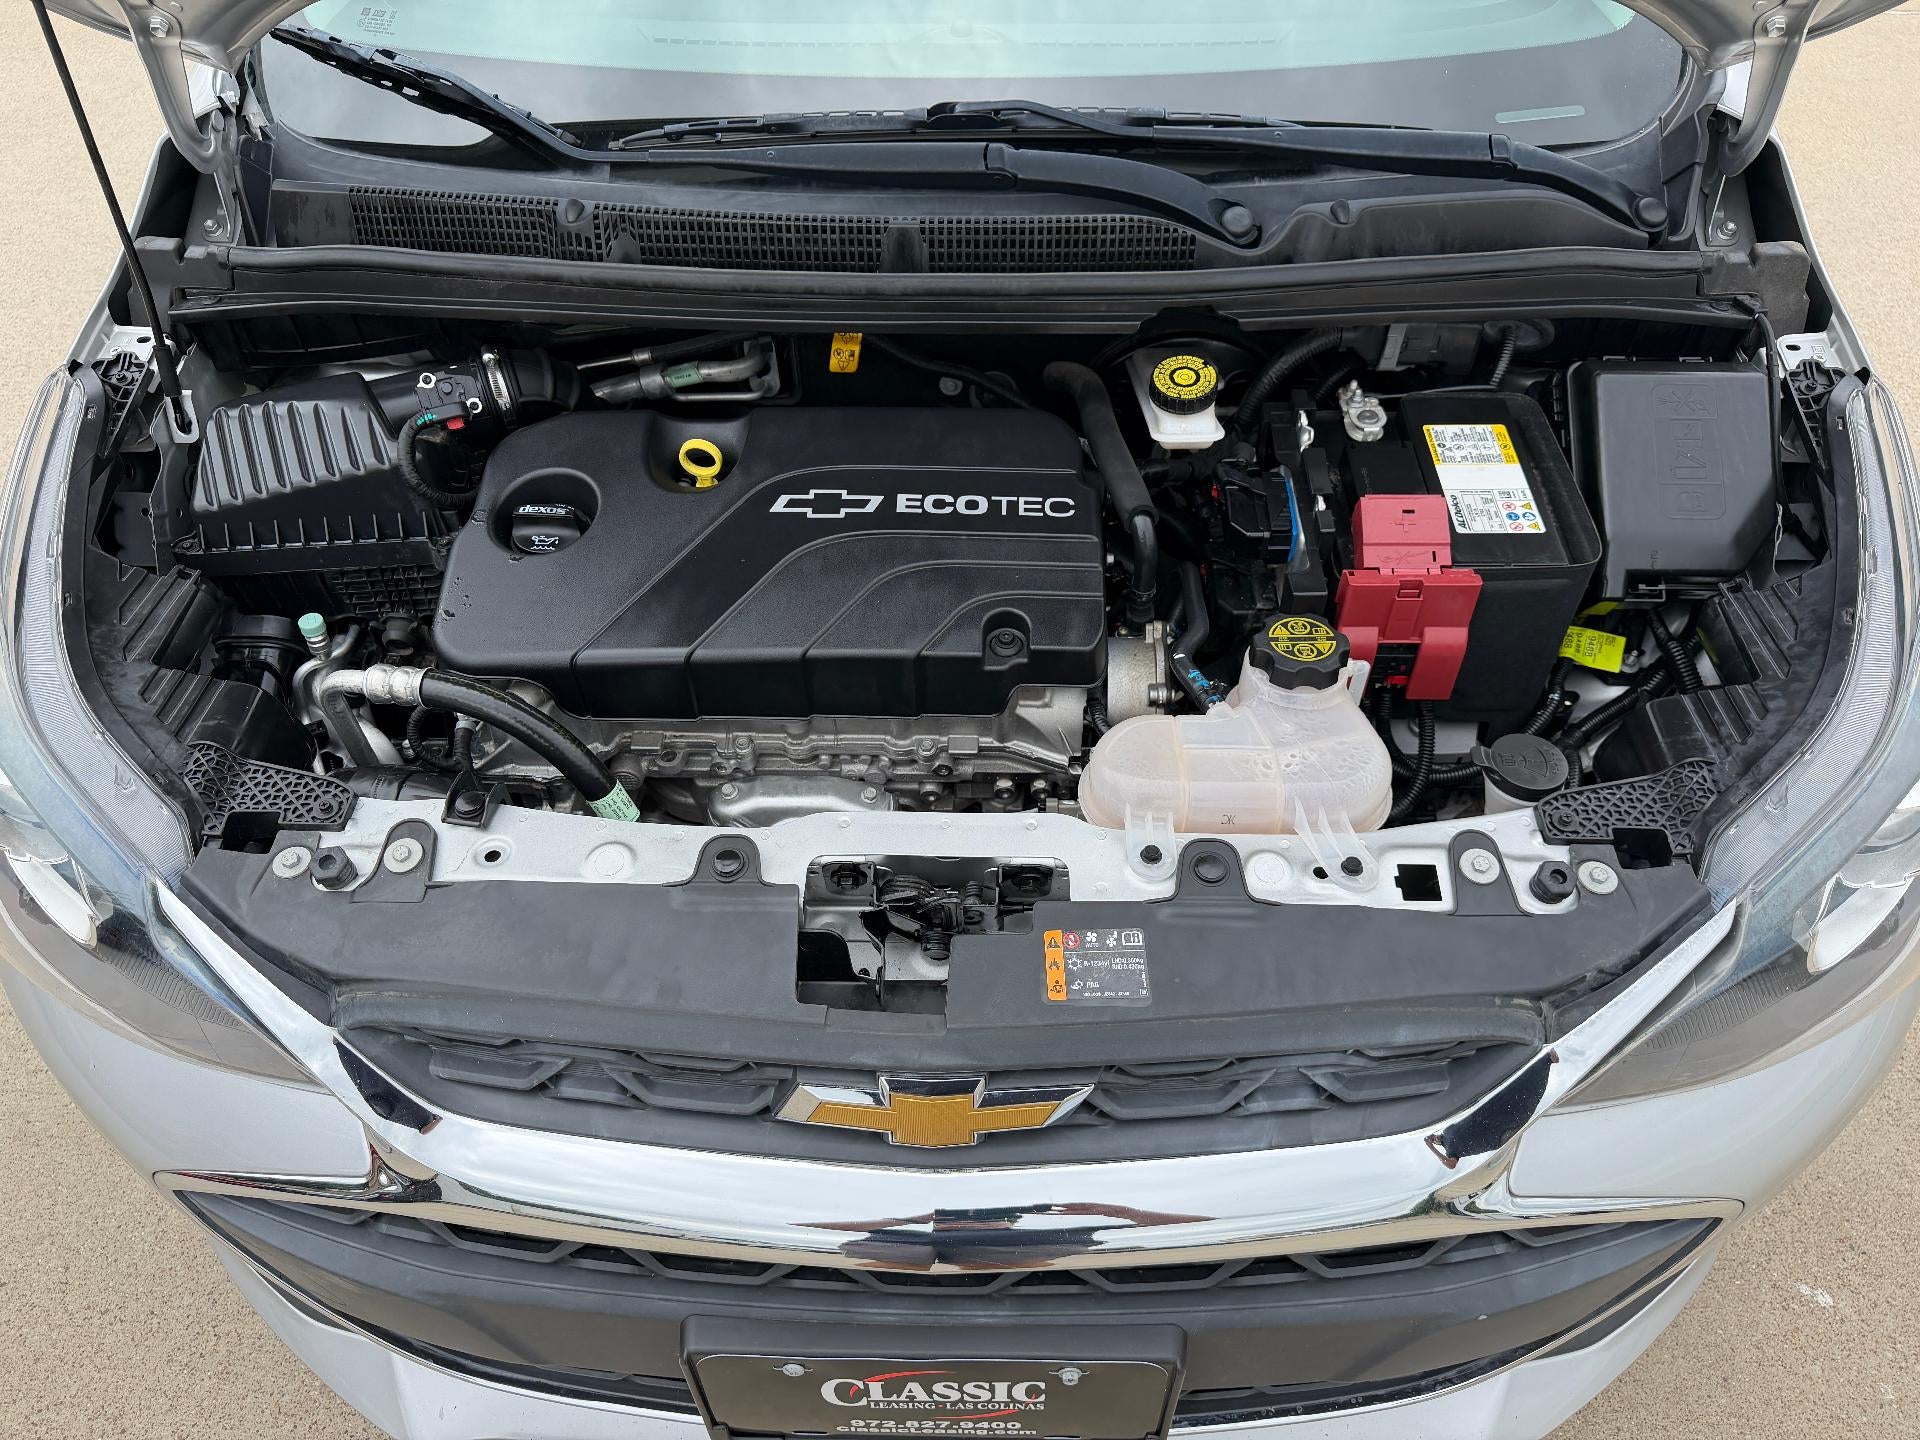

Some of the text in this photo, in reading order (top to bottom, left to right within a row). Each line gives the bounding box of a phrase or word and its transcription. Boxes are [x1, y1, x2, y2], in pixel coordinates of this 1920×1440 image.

[519, 505, 566, 515] dexos
[896, 493, 1076, 517] ECOTEC
[1450, 494, 1468, 530] ACDelco
[1585, 635, 1597, 657] 9488
[820, 1378, 1046, 1407] CLASSIC
[869, 1401, 1045, 1410] LEASING LAS COLINAS
[850, 1419, 1021, 1429] 972.827.9400
